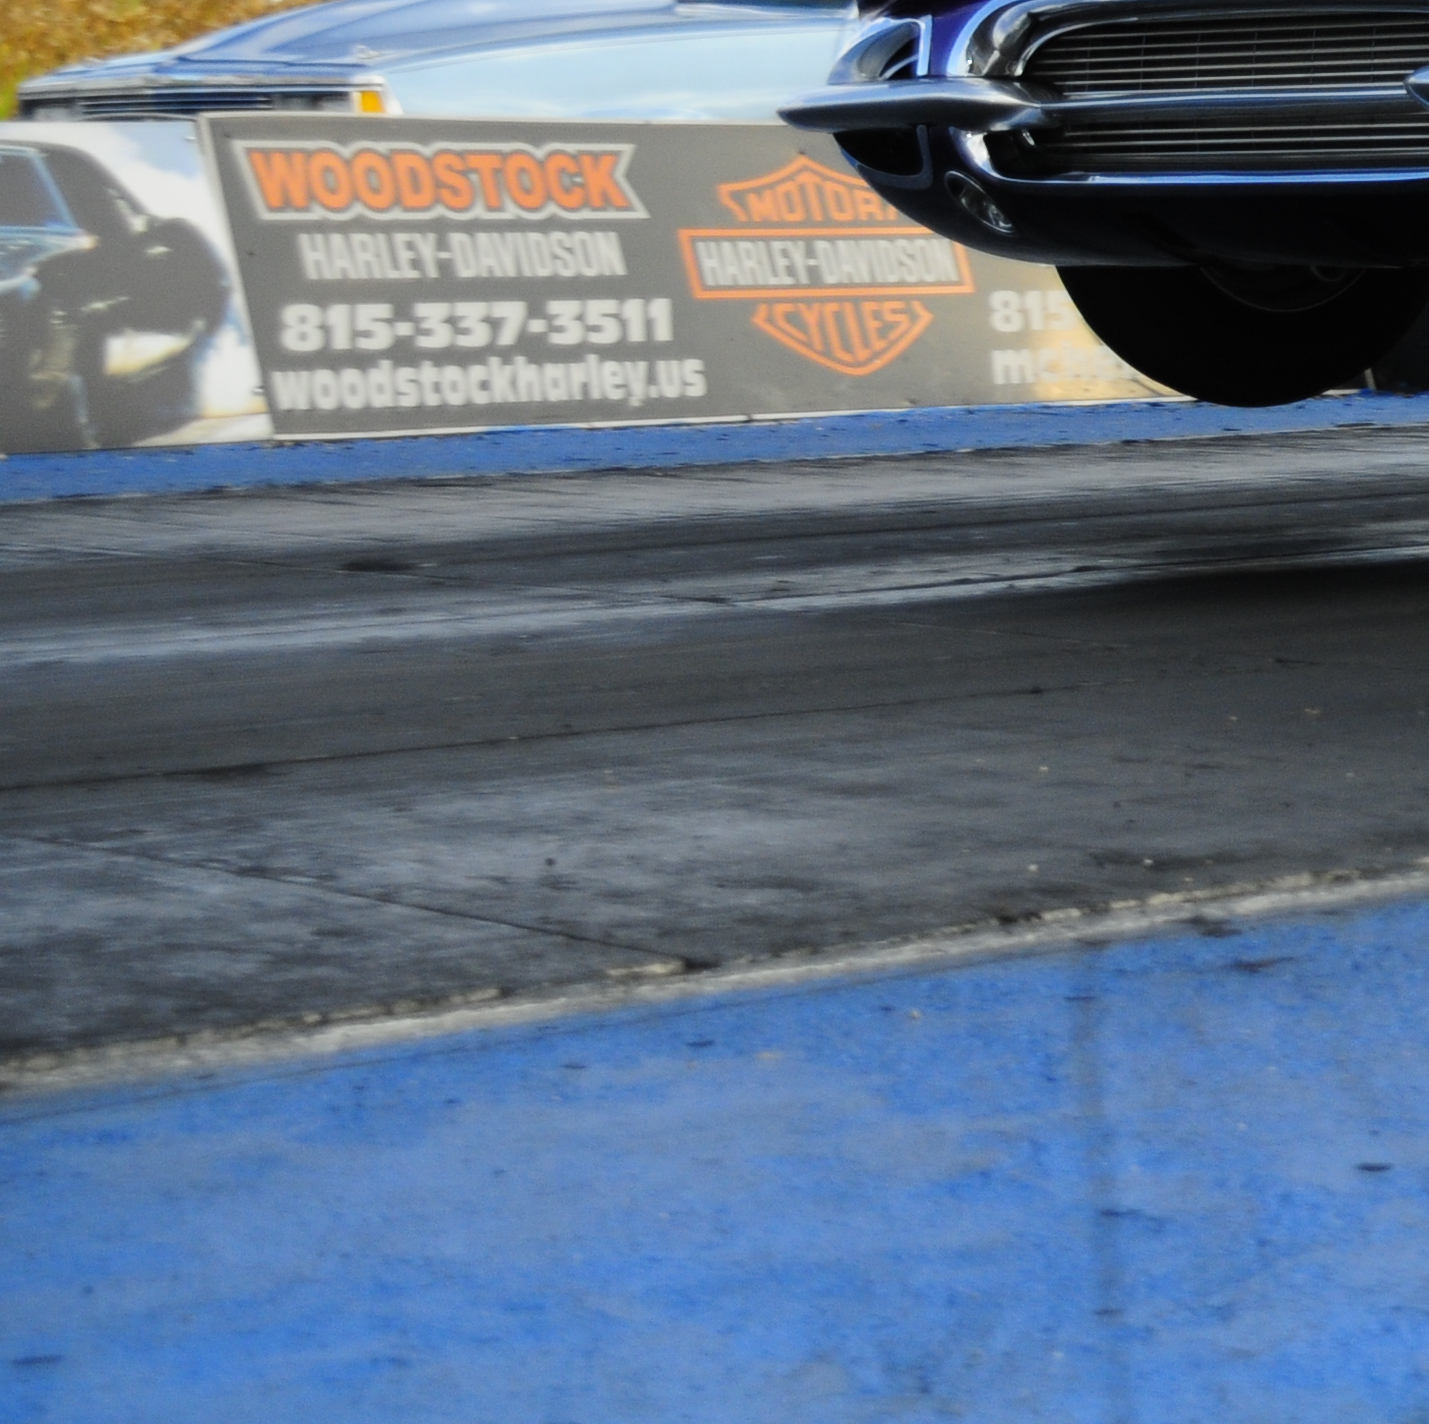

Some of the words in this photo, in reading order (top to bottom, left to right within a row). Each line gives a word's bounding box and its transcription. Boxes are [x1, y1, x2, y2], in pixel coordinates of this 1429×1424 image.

[247, 148, 632, 211] WOODSTOCK
[301, 231, 627, 280] HARLEY-DAVIDSON
[695, 237, 960, 286] HARLEY-DAVIDSON
[280, 297, 673, 352] 815-337-3511
[772, 300, 912, 363] CYCLES
[271, 353, 706, 410] woodstockharley.us
